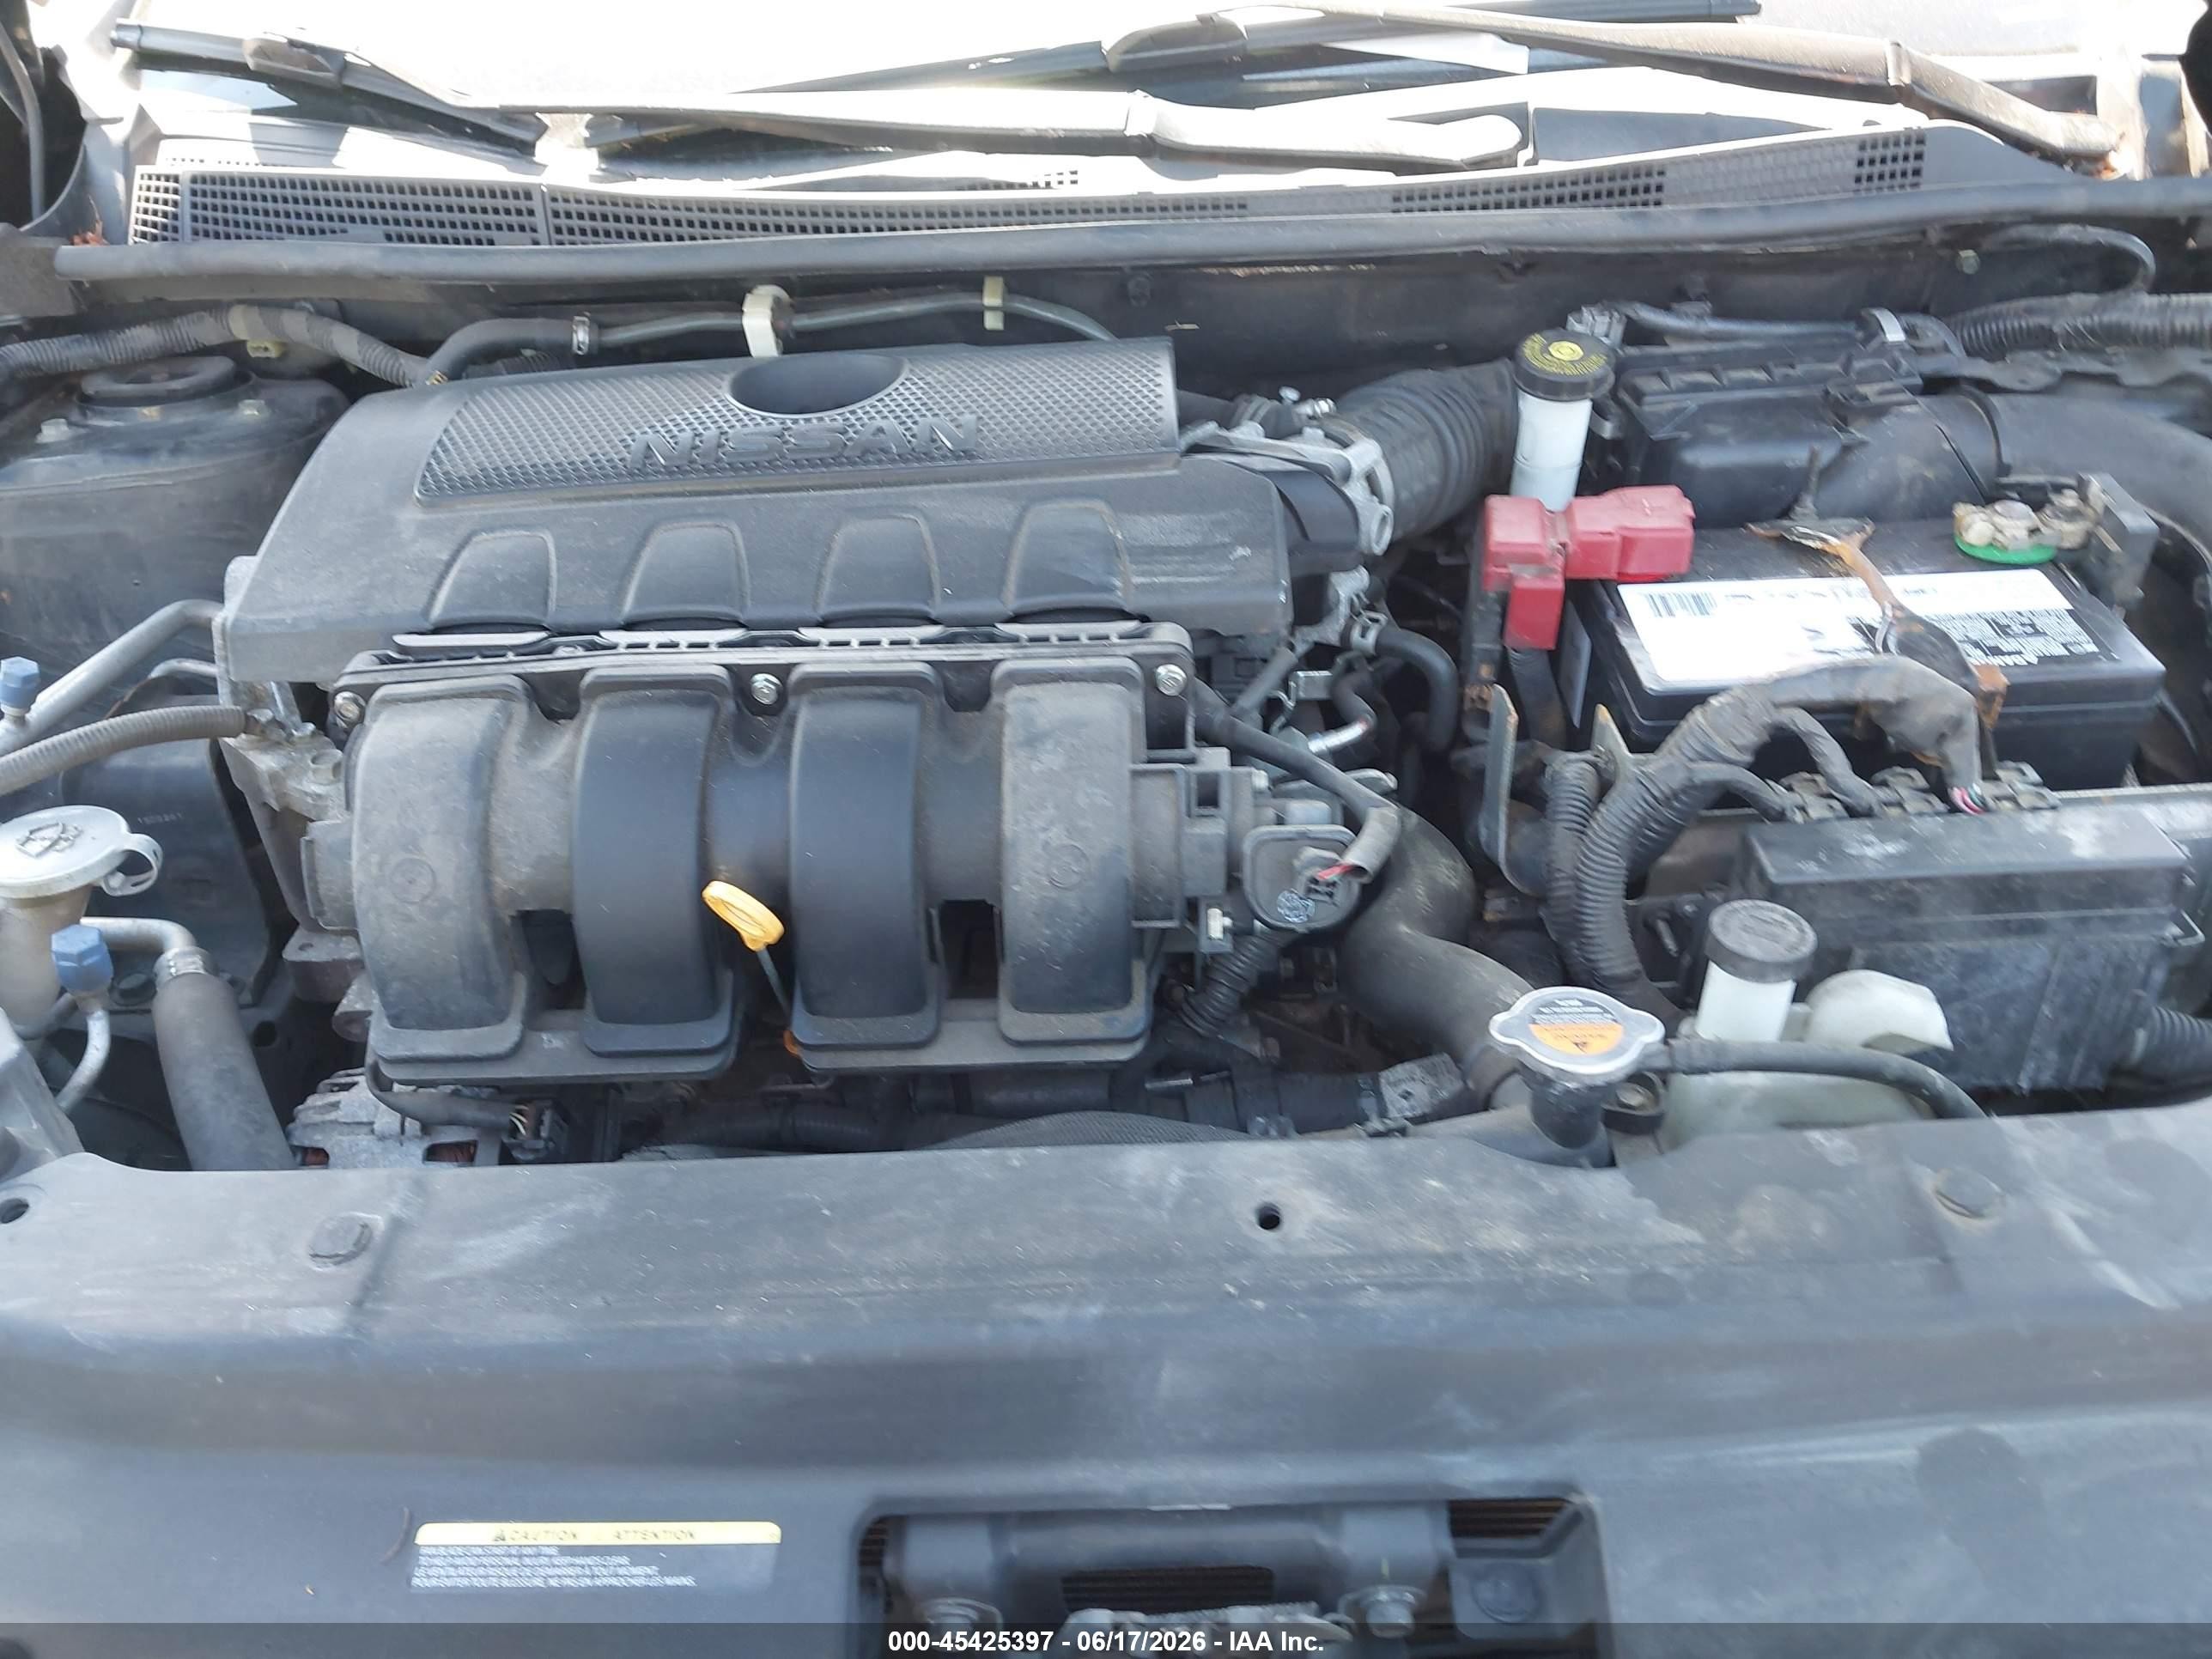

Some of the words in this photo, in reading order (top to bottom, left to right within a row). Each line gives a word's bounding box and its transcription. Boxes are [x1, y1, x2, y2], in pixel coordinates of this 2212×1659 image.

[629, 415, 979, 471] NISSAN
[509, 1528, 579, 1541] CAUTION
[612, 1528, 697, 1541] ATTENTION
